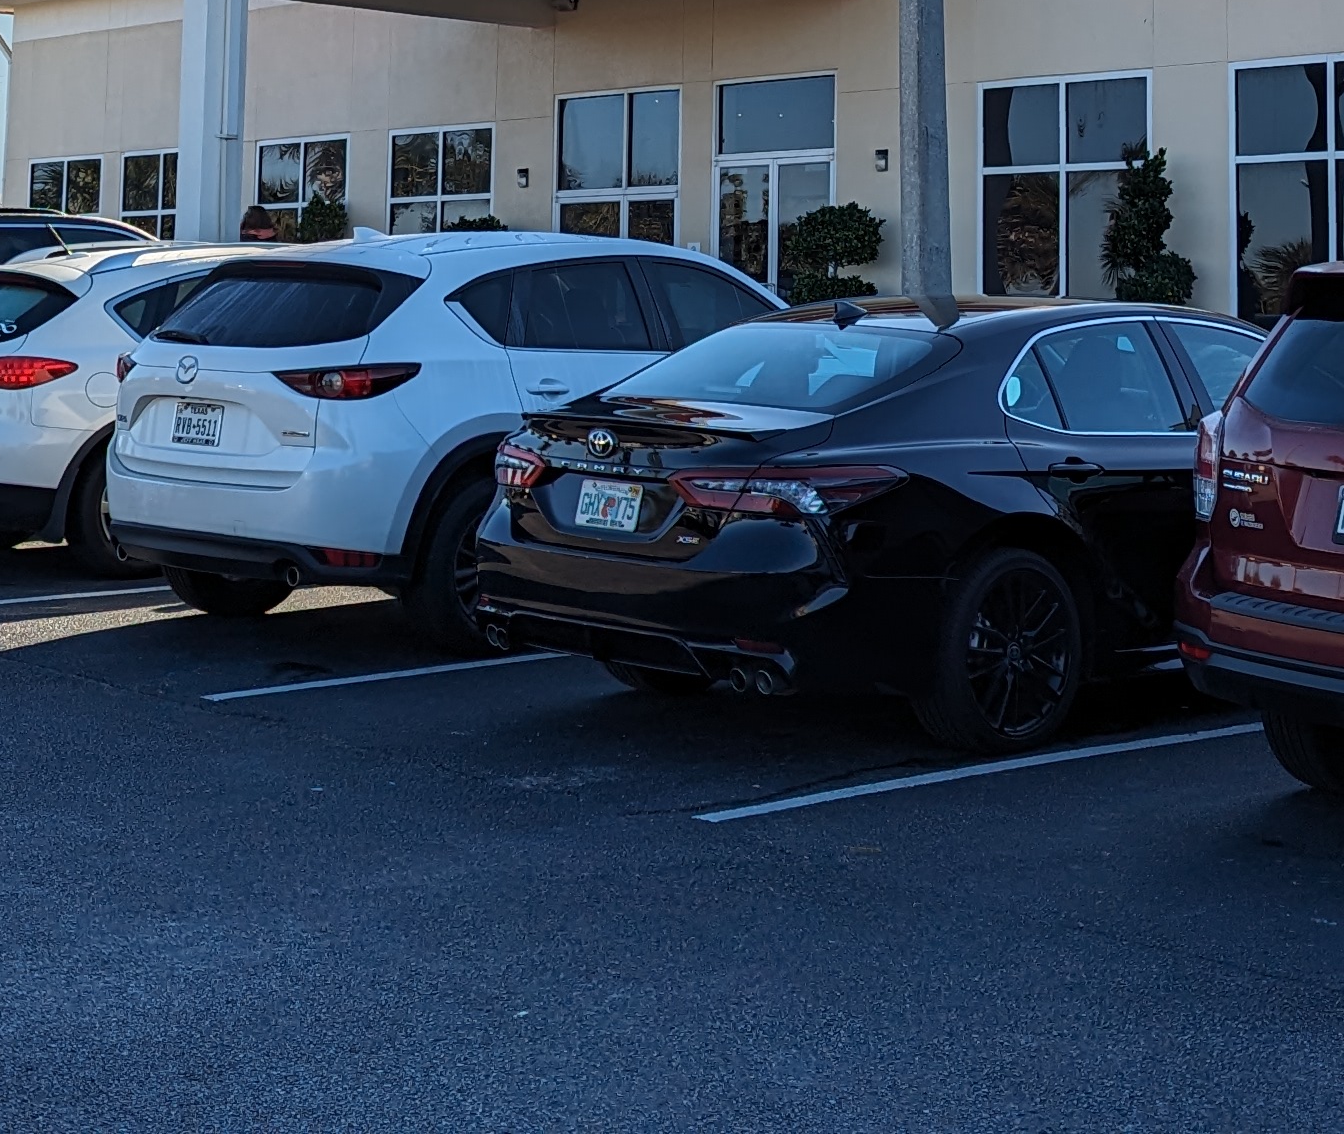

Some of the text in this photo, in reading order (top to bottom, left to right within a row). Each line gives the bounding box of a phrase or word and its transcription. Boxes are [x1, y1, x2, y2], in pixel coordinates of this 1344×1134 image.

[190, 405, 208, 415] TEXAS
[561, 461, 644, 474] CAMRY
[1222, 469, 1269, 485] SUBARU
